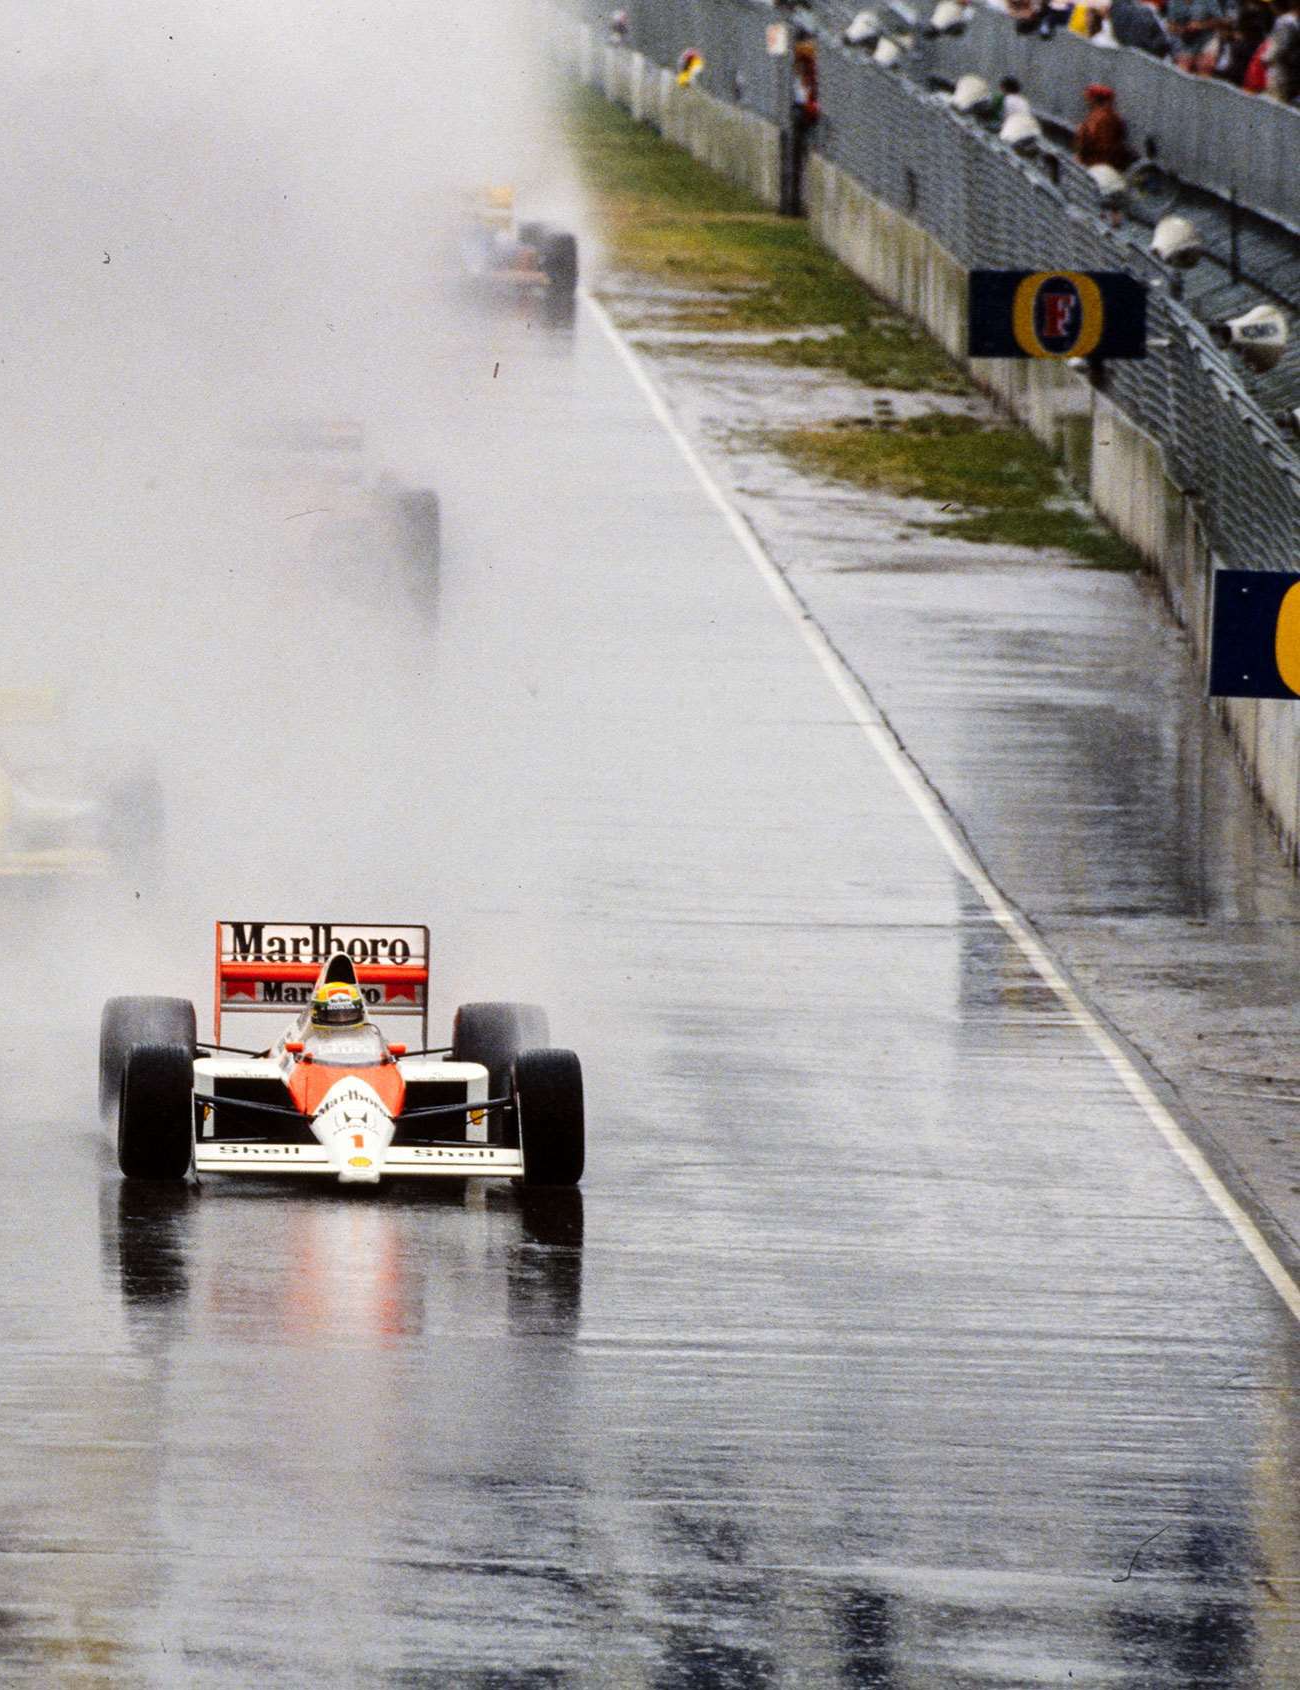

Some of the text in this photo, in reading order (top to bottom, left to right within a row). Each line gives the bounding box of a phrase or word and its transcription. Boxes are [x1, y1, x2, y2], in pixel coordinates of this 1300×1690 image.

[231, 924, 411, 966] Marlboro
[350, 1134, 365, 1149] 1
[218, 1145, 301, 1155] Shell
[413, 1148, 496, 1158] Shell
